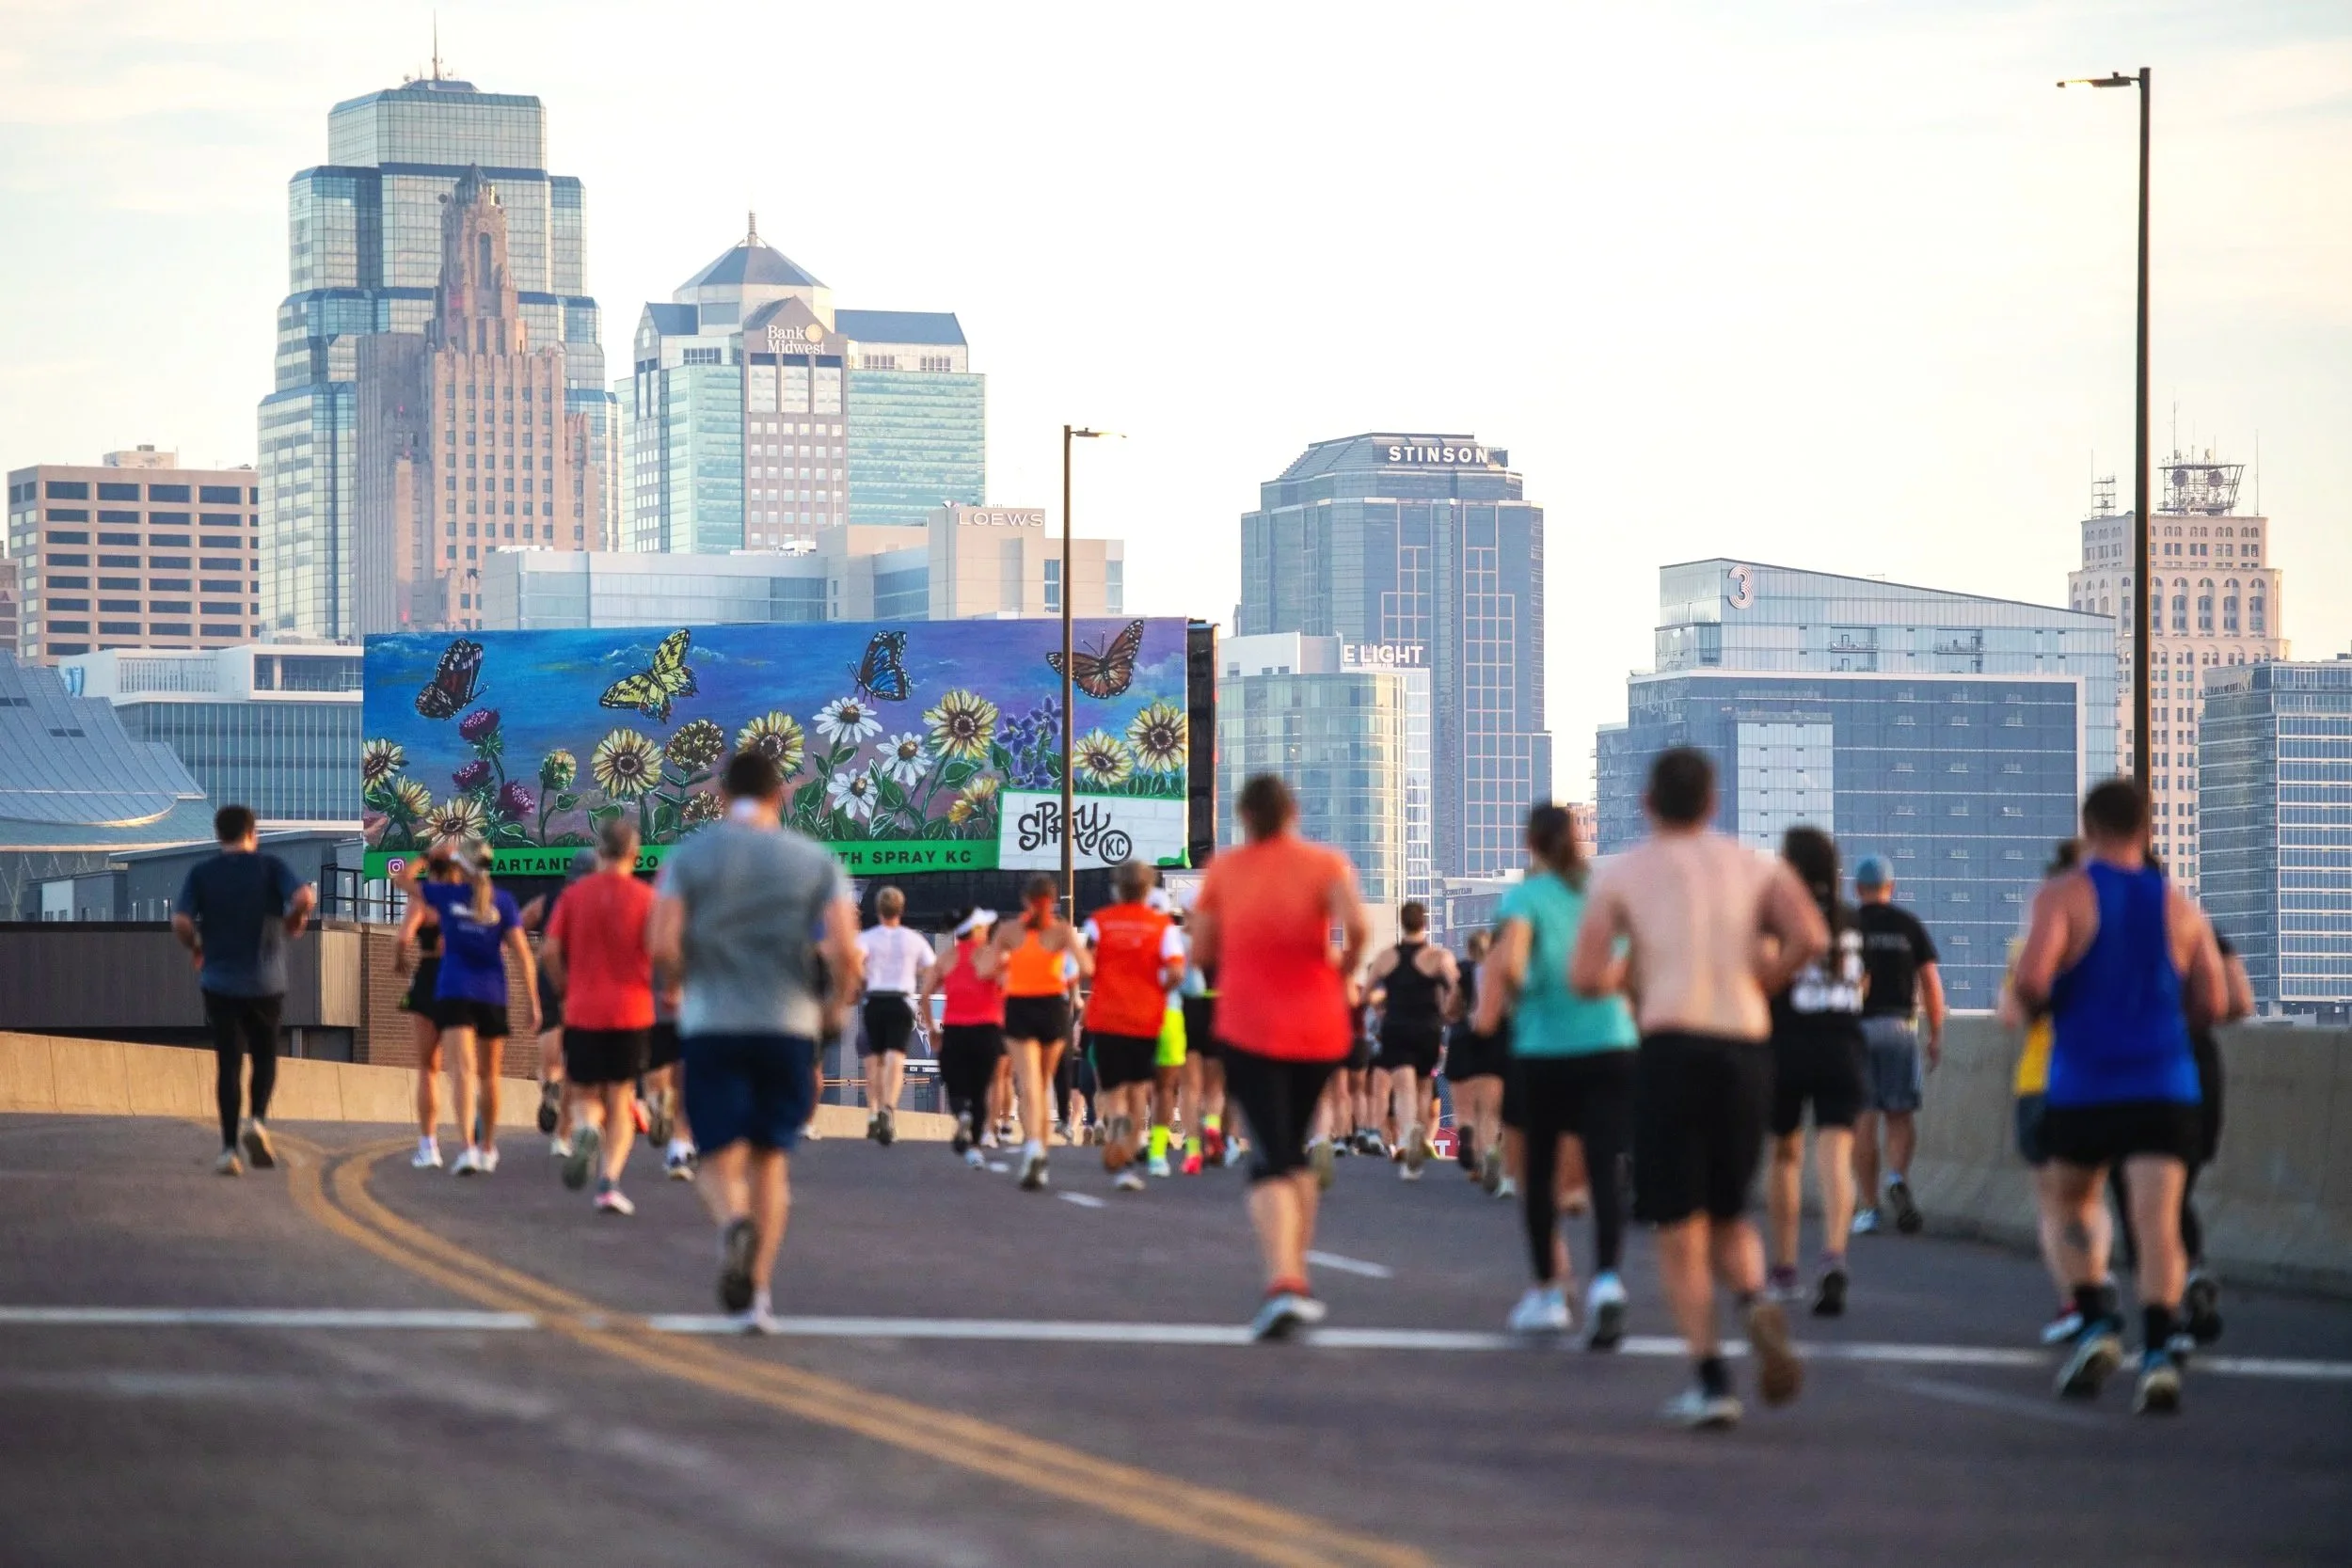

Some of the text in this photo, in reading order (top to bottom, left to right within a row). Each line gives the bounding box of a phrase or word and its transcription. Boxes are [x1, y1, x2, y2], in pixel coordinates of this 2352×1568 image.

[767, 325, 805, 340] Bank
[767, 340, 826, 355] Midwest
[1389, 445, 1487, 463] STINSON
[958, 512, 1044, 527] LOEWS
[1727, 564, 1755, 610] 3
[1359, 644, 1423, 664] LIGHT
[1104, 838, 1125, 857] KC
[872, 850, 936, 864] SPRAY
[946, 850, 972, 863] KC
